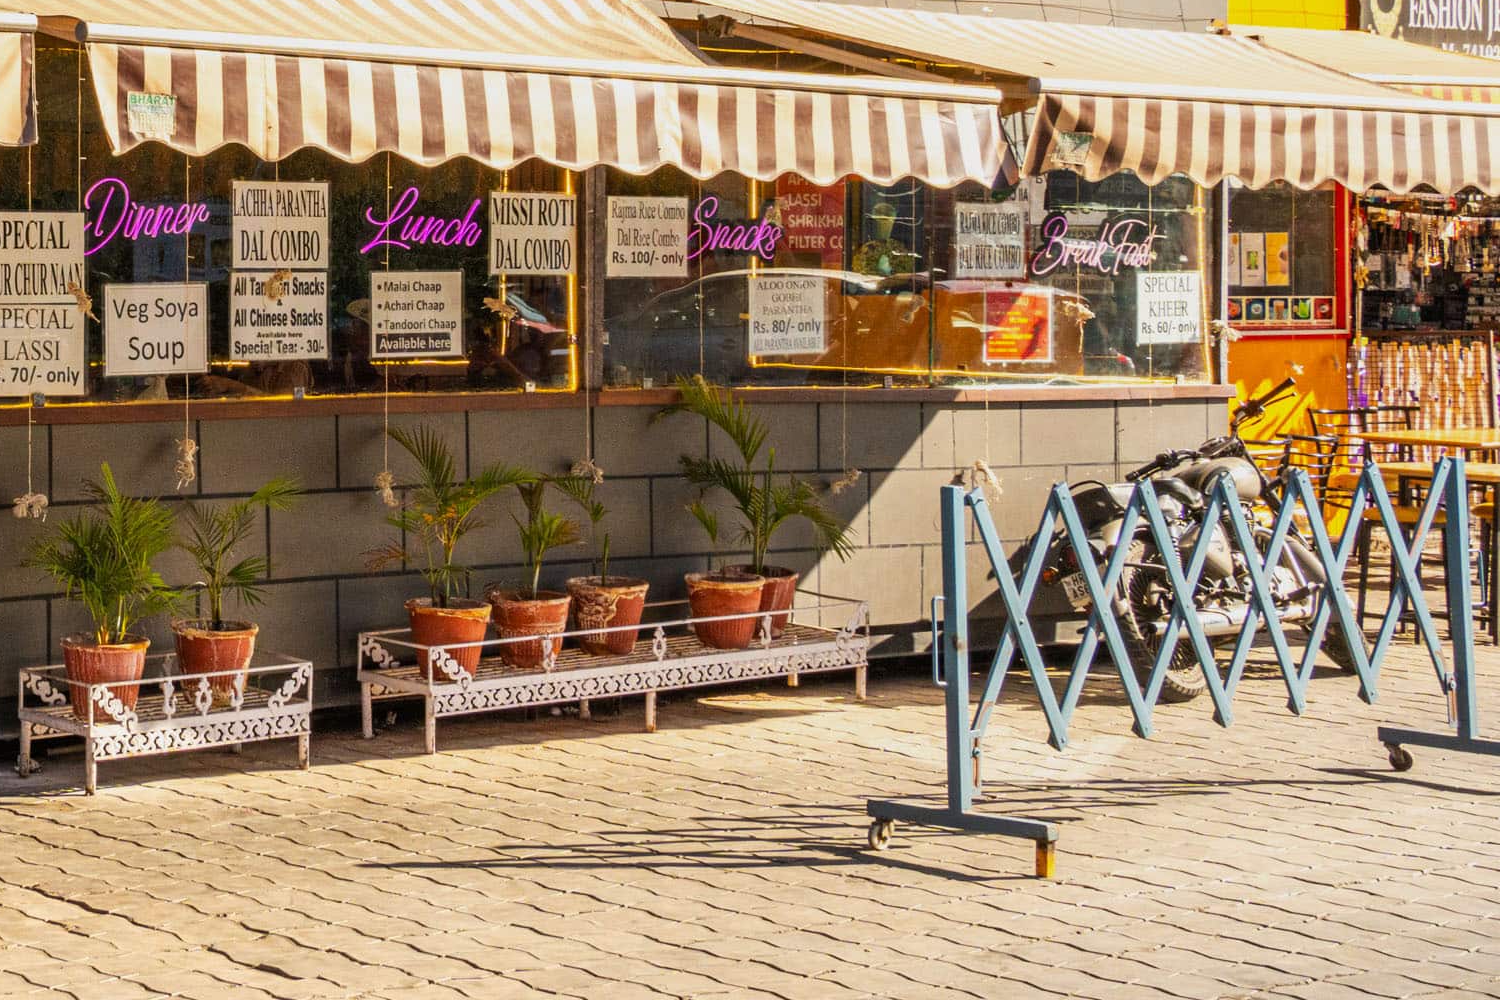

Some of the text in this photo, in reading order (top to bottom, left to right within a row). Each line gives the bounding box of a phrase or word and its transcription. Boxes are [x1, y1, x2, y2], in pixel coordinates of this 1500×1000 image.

[233, 188, 326, 218] LACHHA PARANTHA
[788, 193, 822, 207] LASSI
[84, 177, 210, 257] Dinner
[360, 186, 483, 254] Lunch
[491, 198, 575, 226] MISSI ROTI
[612, 201, 685, 223] Rajma Rice Combo
[617, 228, 680, 247] Dal Rice Combo
[687, 196, 783, 260] Snacks
[240, 229, 320, 262] DAL COMBO
[788, 235, 826, 249] FILTER
[1031, 216, 1168, 276] Break Fast
[495, 238, 571, 270] DAL COMBO
[612, 250, 684, 267] Rs. 100/- only
[14, 262, 48, 296] CHUR
[50, 262, 83, 296] NAAN
[234, 276, 247, 296] All
[292, 276, 325, 296] Snacks
[383, 281, 442, 294] Malai Chaap
[1144, 276, 1193, 293] SPECIAL
[113, 298, 198, 324] Veg Soya
[383, 300, 445, 312] Achari Chaap
[1149, 300, 1188, 317] KHEER
[234, 308, 324, 327] All Chinese Snacks
[383, 318, 457, 331] Tandoori Chaap
[753, 318, 821, 335] Rs. 80/- only
[1141, 320, 1197, 336] Rs. 60/- only
[3, 339, 61, 361] LASSI
[128, 336, 185, 365] Soup
[234, 340, 273, 357] Special
[379, 336, 451, 350] Available here
[11, 365, 42, 385] 70/-
[46, 367, 80, 387] only
